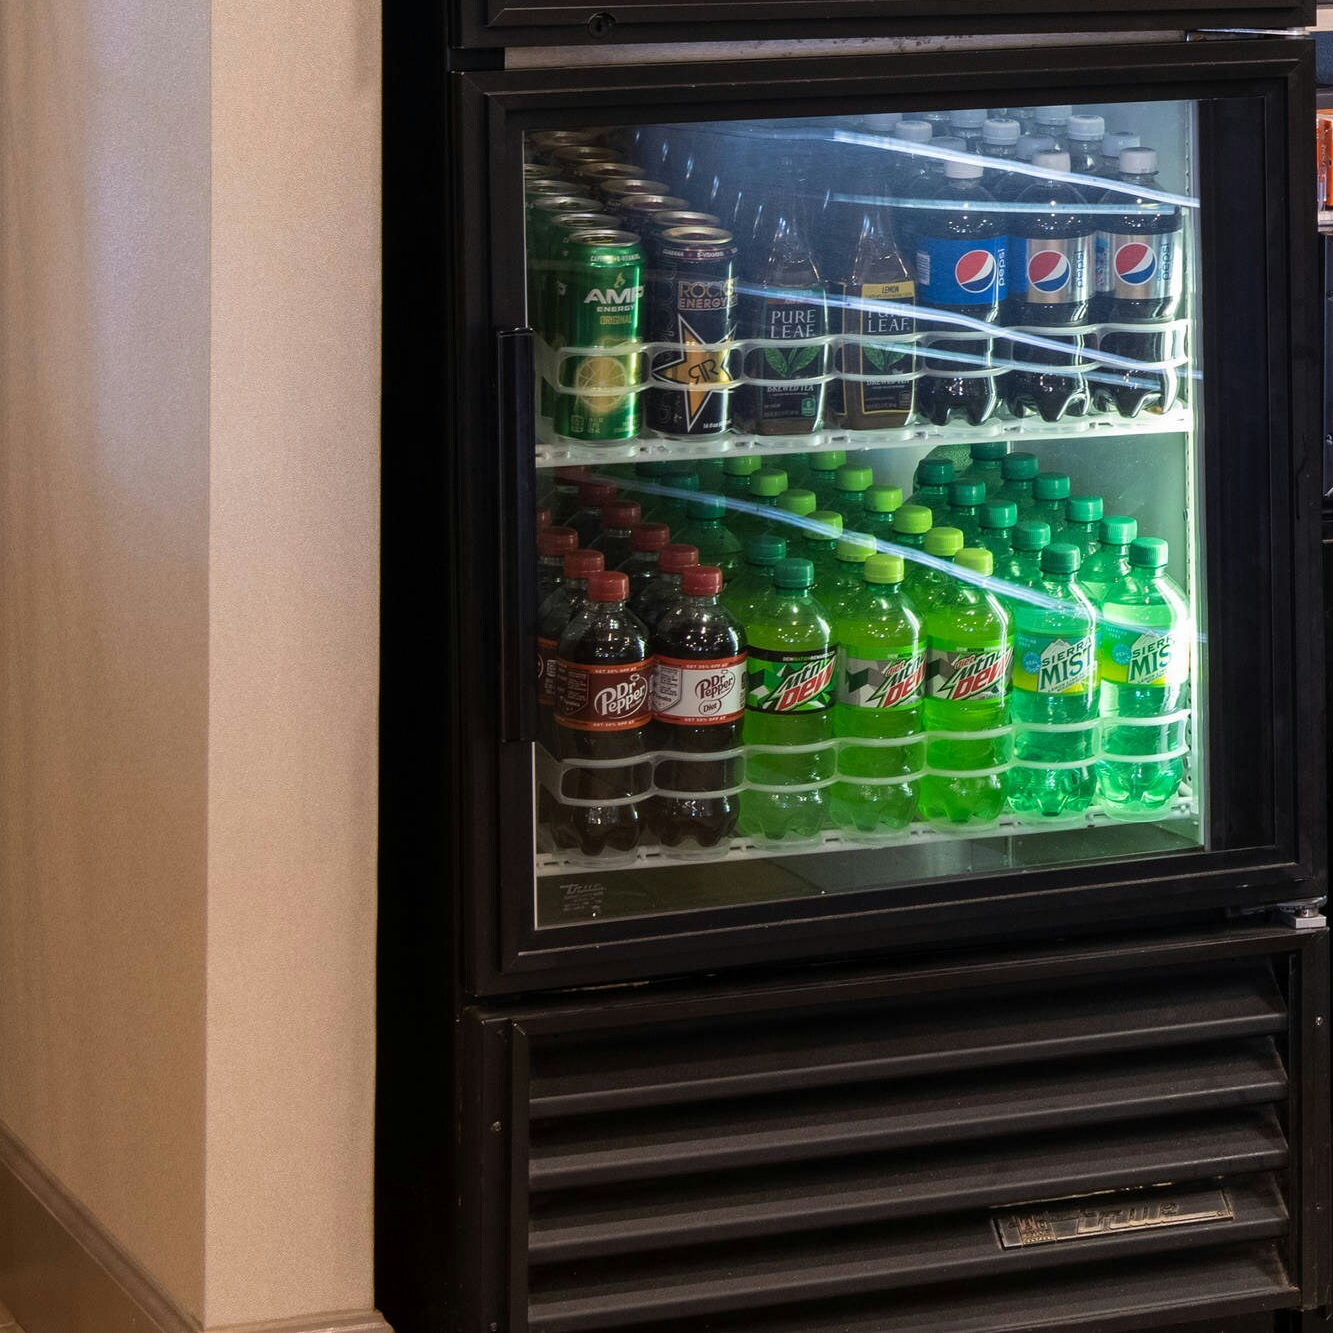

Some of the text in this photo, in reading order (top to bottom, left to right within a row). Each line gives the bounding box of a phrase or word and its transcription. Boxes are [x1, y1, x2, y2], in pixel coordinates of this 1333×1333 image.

[584, 286, 644, 304] AMP
[597, 305, 635, 313] ENERGY
[771, 310, 816, 324] PURE
[771, 325, 815, 338] LEAF
[868, 320, 908, 333] LEAF
[1041, 637, 1093, 666] SIERRA
[1040, 647, 1094, 690] MIST
[711, 674, 726, 688] Dr
[617, 682, 636, 698] Dr
[699, 678, 734, 700] Pepper
[601, 685, 645, 715] Pepper
[702, 702, 720, 713] Diet
